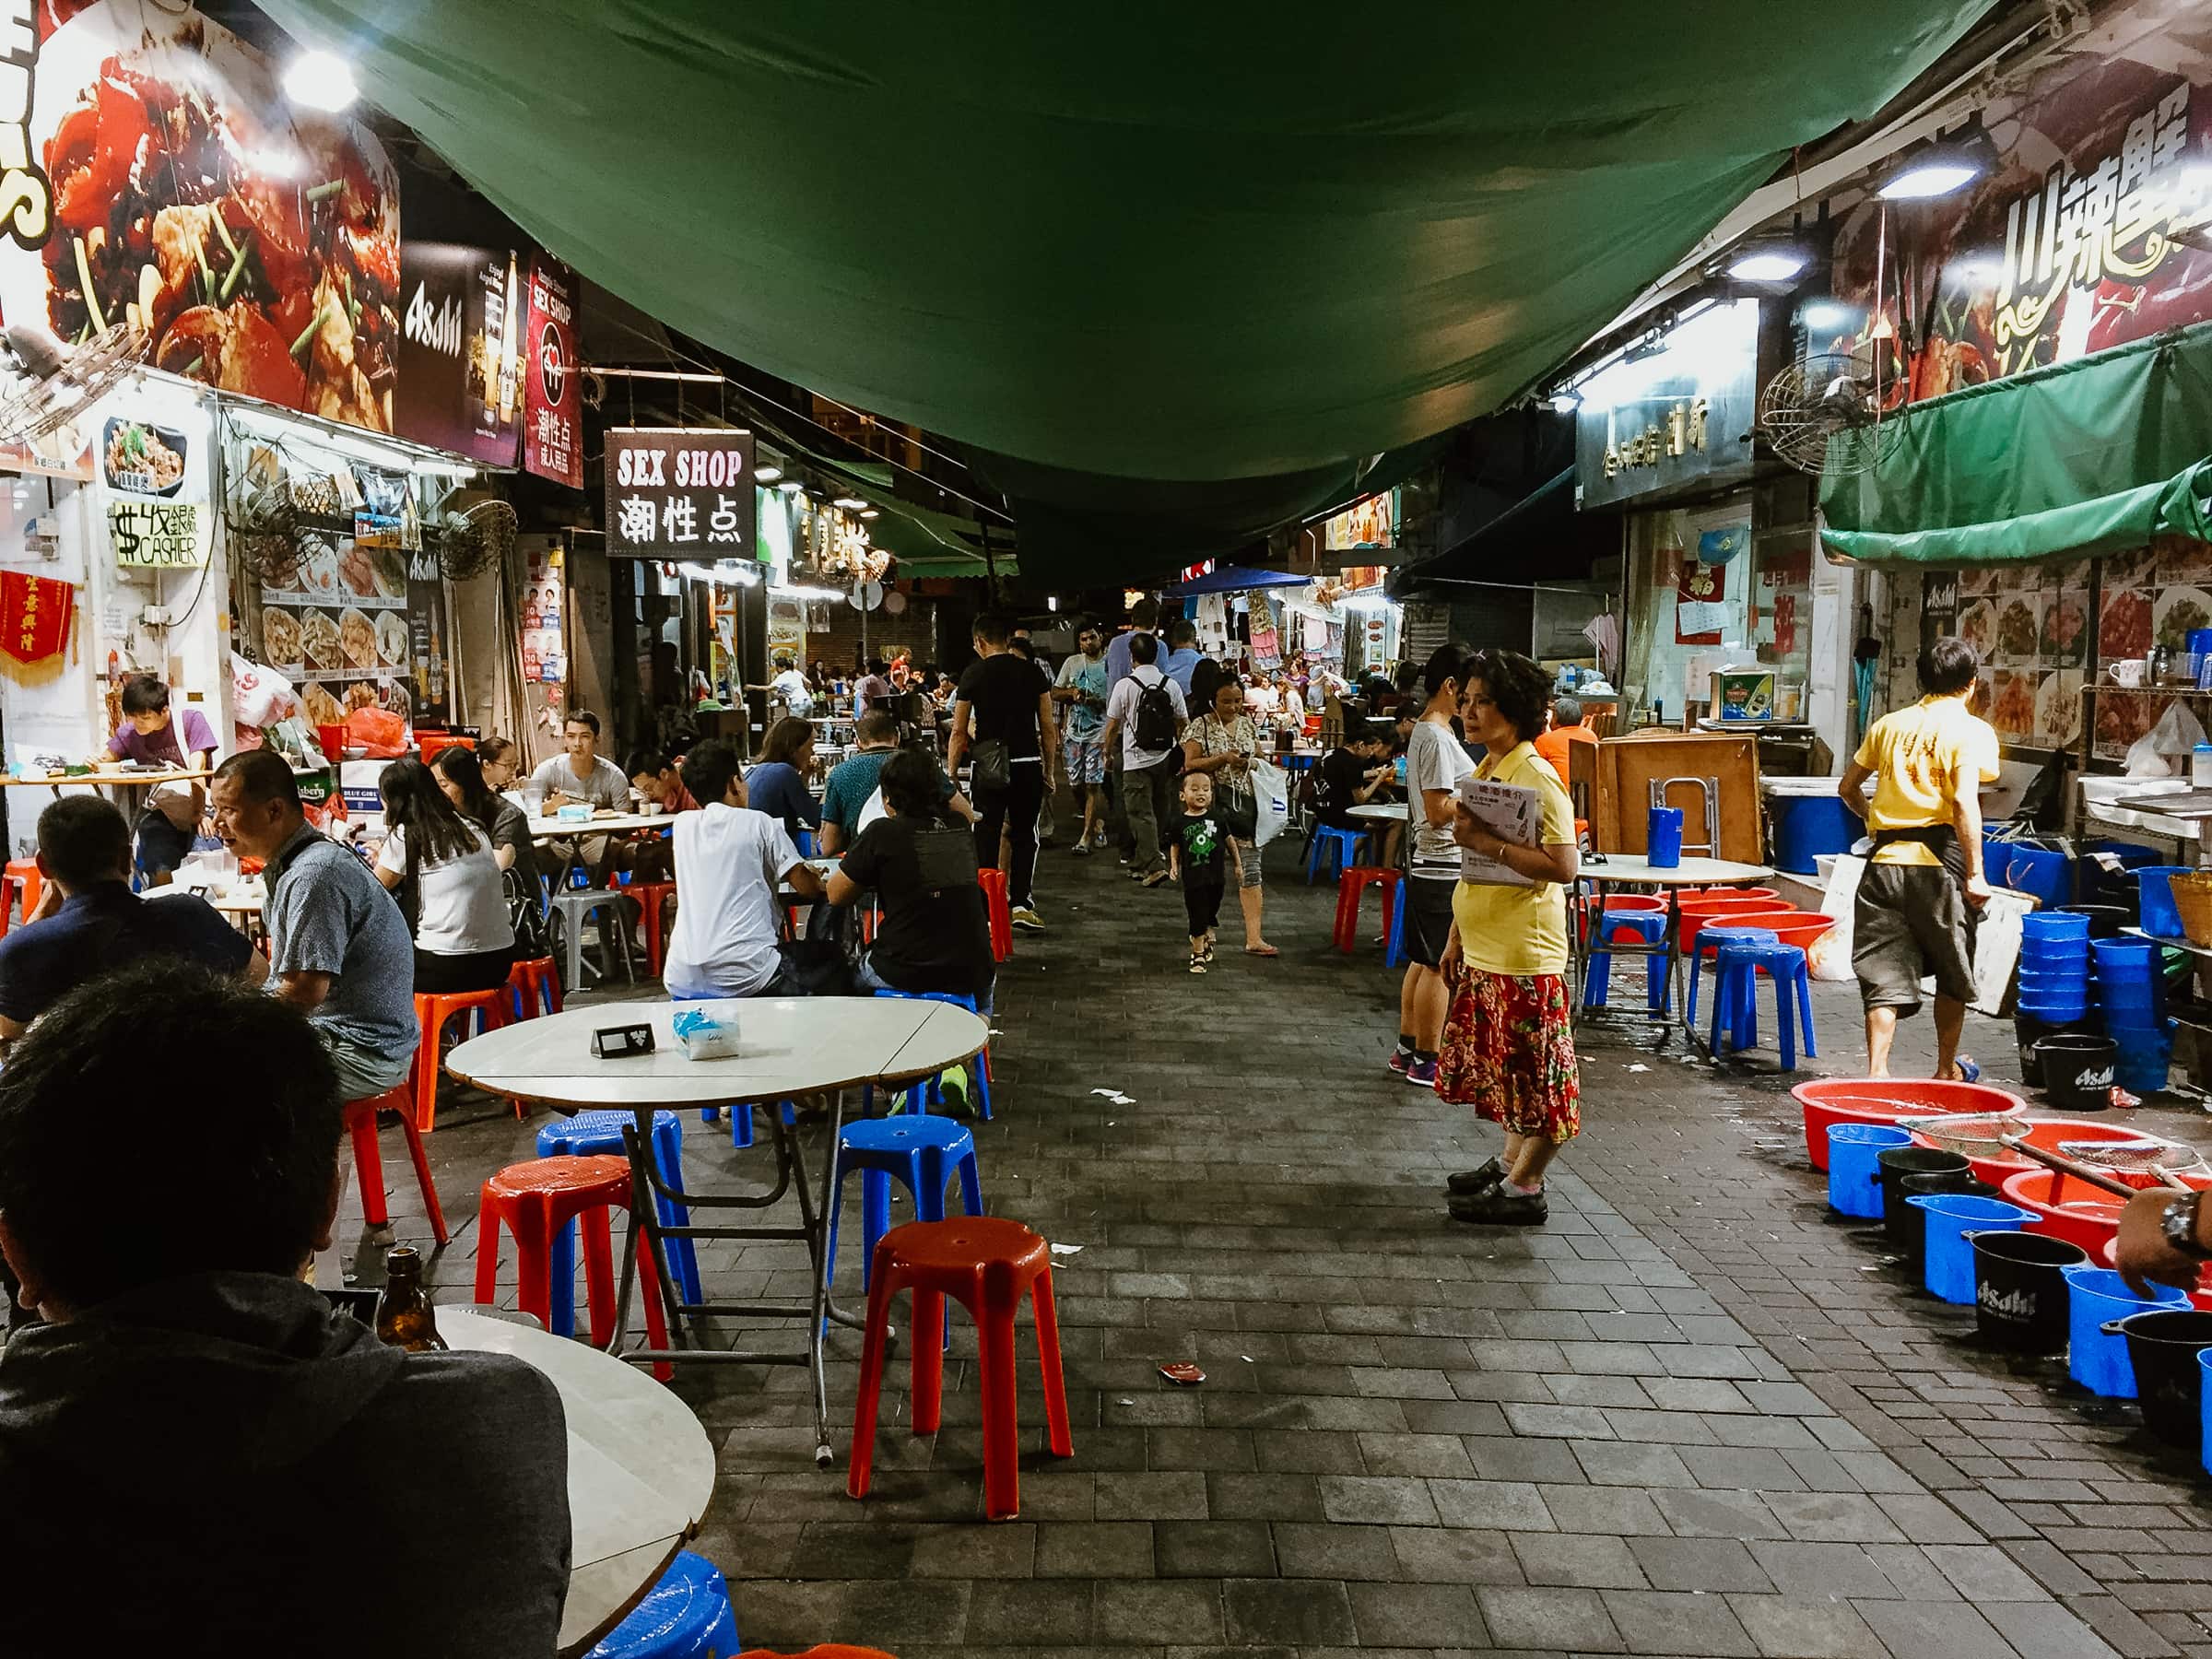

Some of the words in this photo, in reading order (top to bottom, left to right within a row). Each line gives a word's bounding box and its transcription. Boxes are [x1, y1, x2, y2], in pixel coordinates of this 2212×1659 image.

[405, 279, 463, 359] Asahi
[534, 283, 550, 314] SEX
[549, 294, 571, 326] SHOP
[537, 406, 571, 453] 潮性点
[617, 448, 667, 488] SEX
[674, 449, 743, 488] SHOP
[617, 492, 742, 546] 潮性点
[139, 535, 198, 565] CASHIER
[409, 551, 439, 582] Asahi
[344, 790, 360, 798] BLUE
[2075, 1065, 2115, 1086] Asahi
[1977, 1279, 2036, 1315] Asahi
